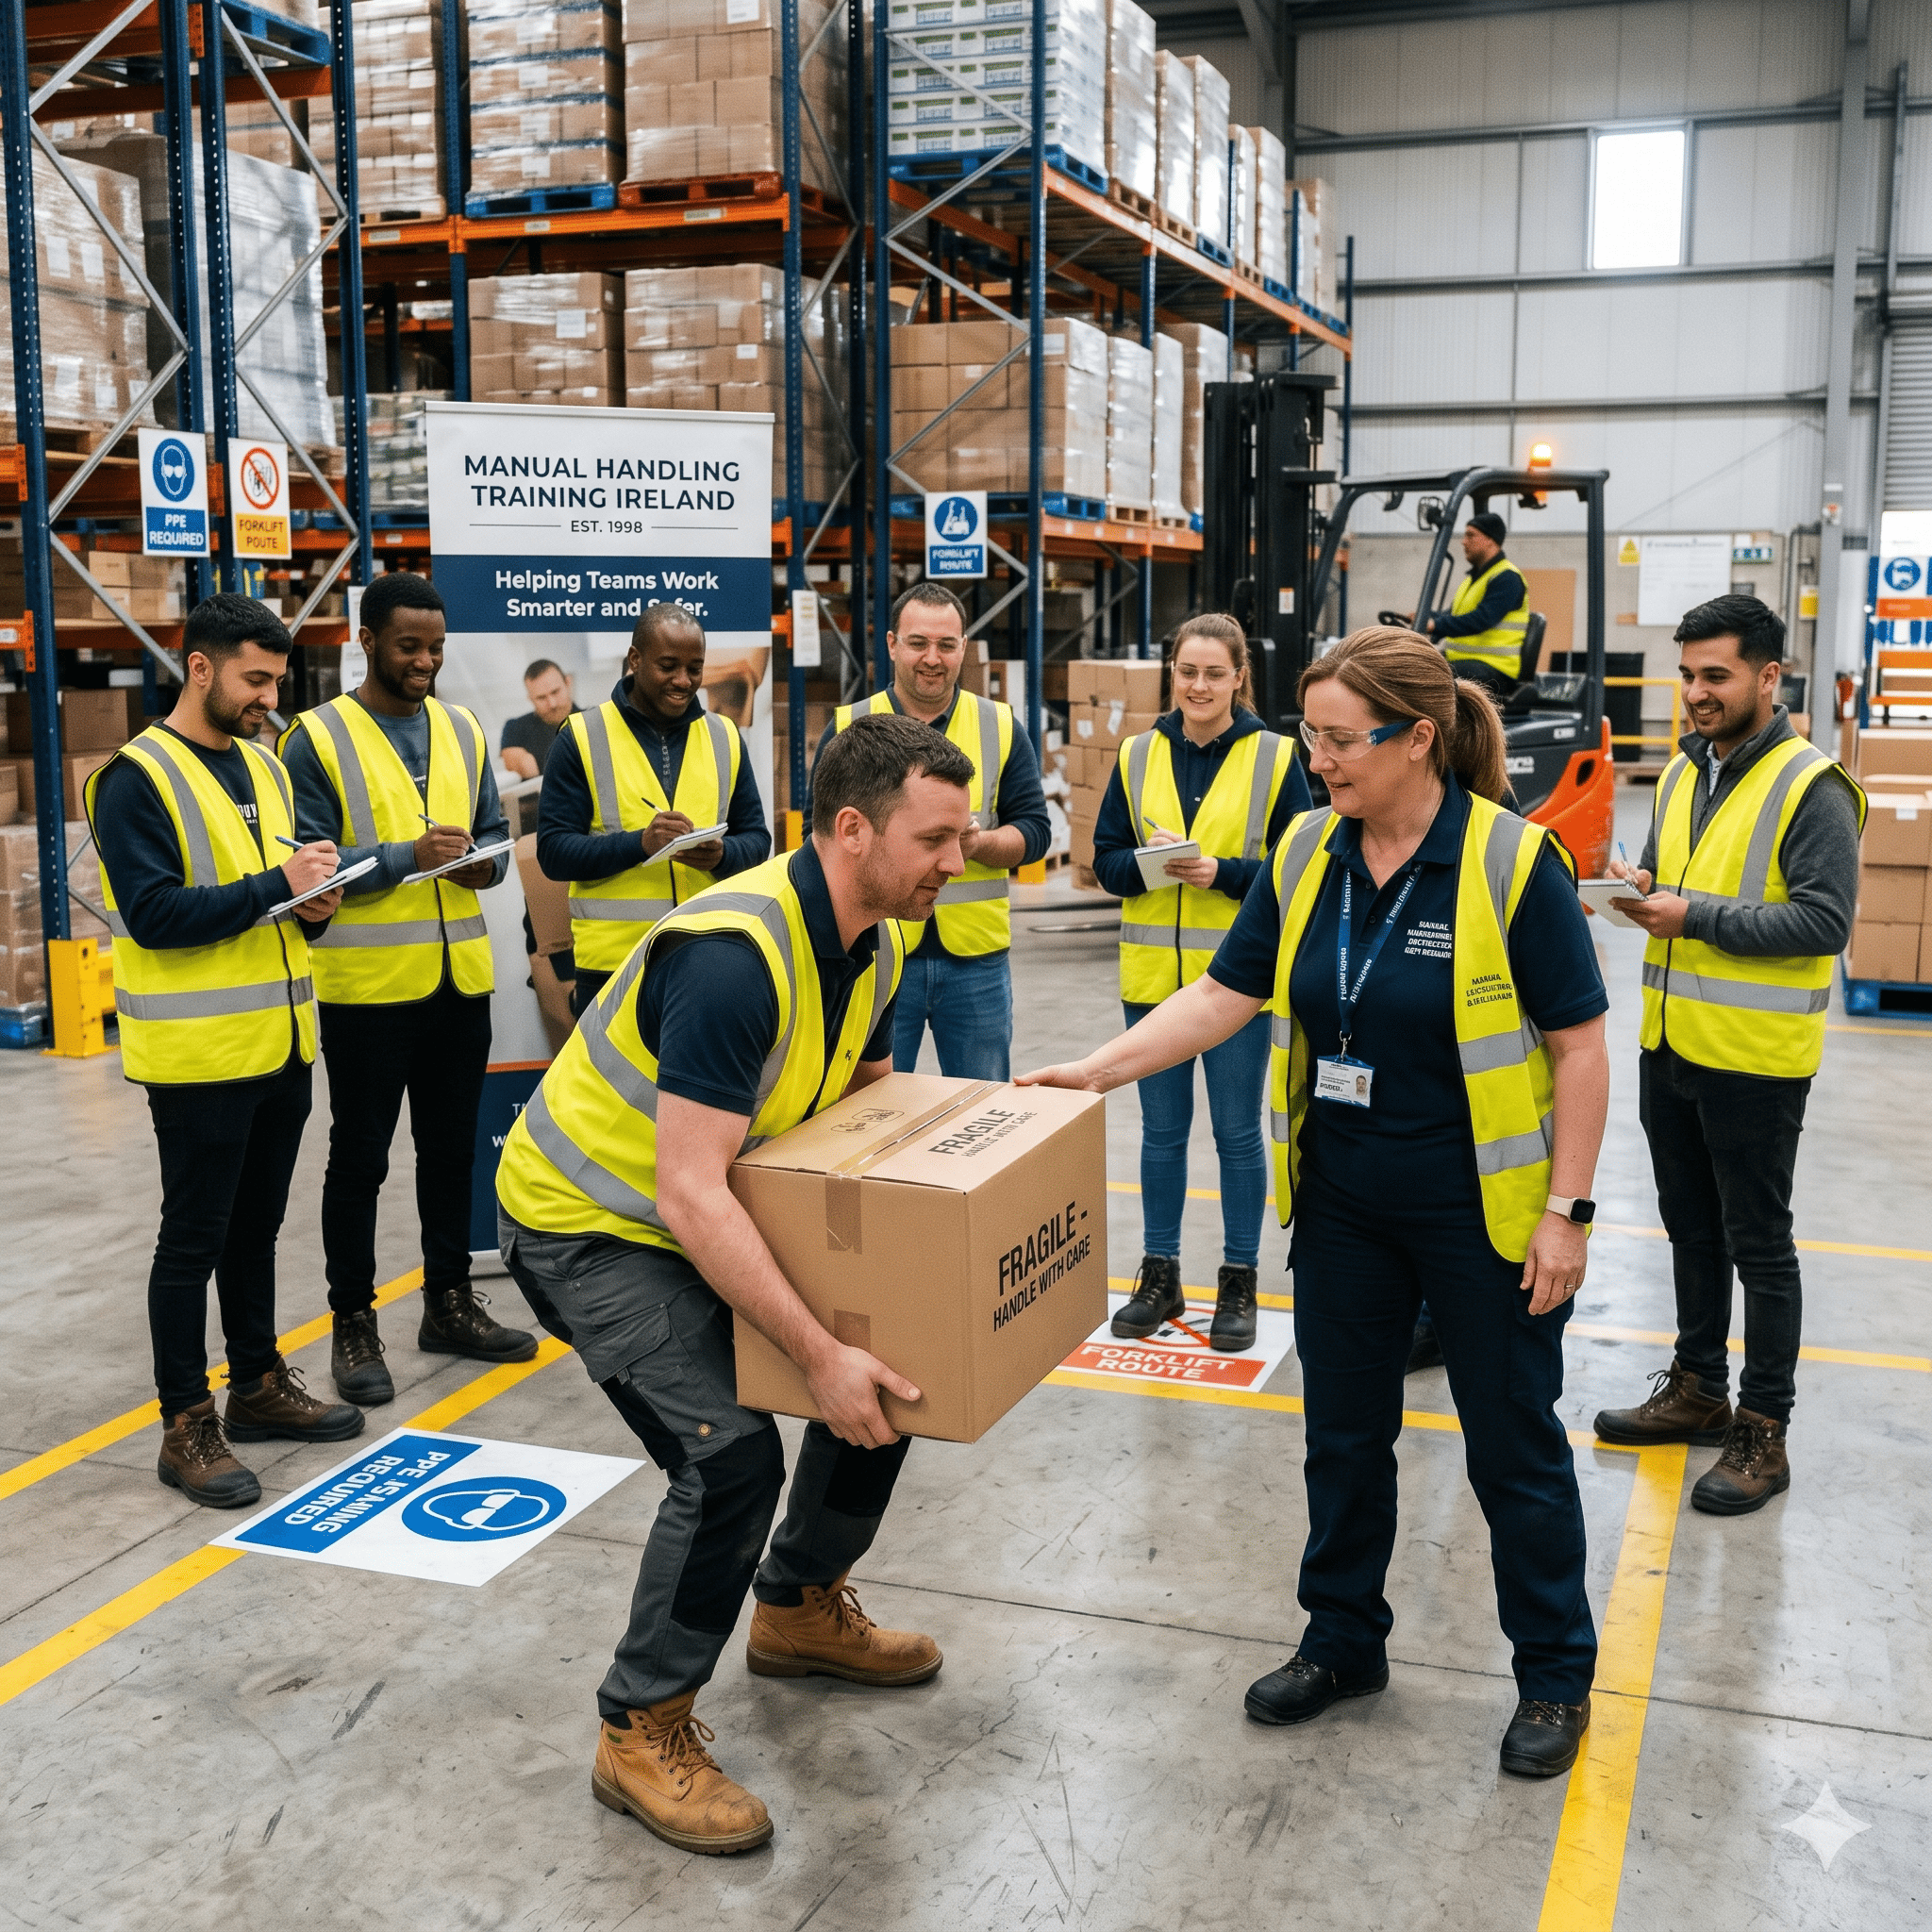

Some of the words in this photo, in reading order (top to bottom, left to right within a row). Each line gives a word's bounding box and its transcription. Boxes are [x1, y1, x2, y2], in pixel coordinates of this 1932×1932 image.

[464, 455, 588, 479] MANUAL
[596, 458, 741, 482] HANDLING
[471, 485, 607, 508] TRAINING
[616, 489, 736, 510] IRELAND
[164, 513, 187, 528] PPE
[570, 520, 604, 534] EST.
[608, 521, 643, 534] 1998
[149, 530, 205, 546] REQUIRED
[495, 570, 581, 593] Helping
[587, 570, 657, 591] Teams
[661, 571, 719, 591] Work
[507, 598, 596, 617] Smarter
[601, 598, 641, 617] and
[647, 597, 708, 617] er.
[927, 1109, 1016, 1155] FRAGILE
[999, 1201, 1076, 1297] FRAGILE
[993, 1279, 1037, 1332] HANDLE
[1039, 1257, 1064, 1294] WITH
[1066, 1234, 1091, 1272] CARE
[1080, 1345, 1236, 1371] FORKLIFT
[1095, 1358, 1207, 1380] ROUTE
[396, 1451, 452, 1479] PPE
